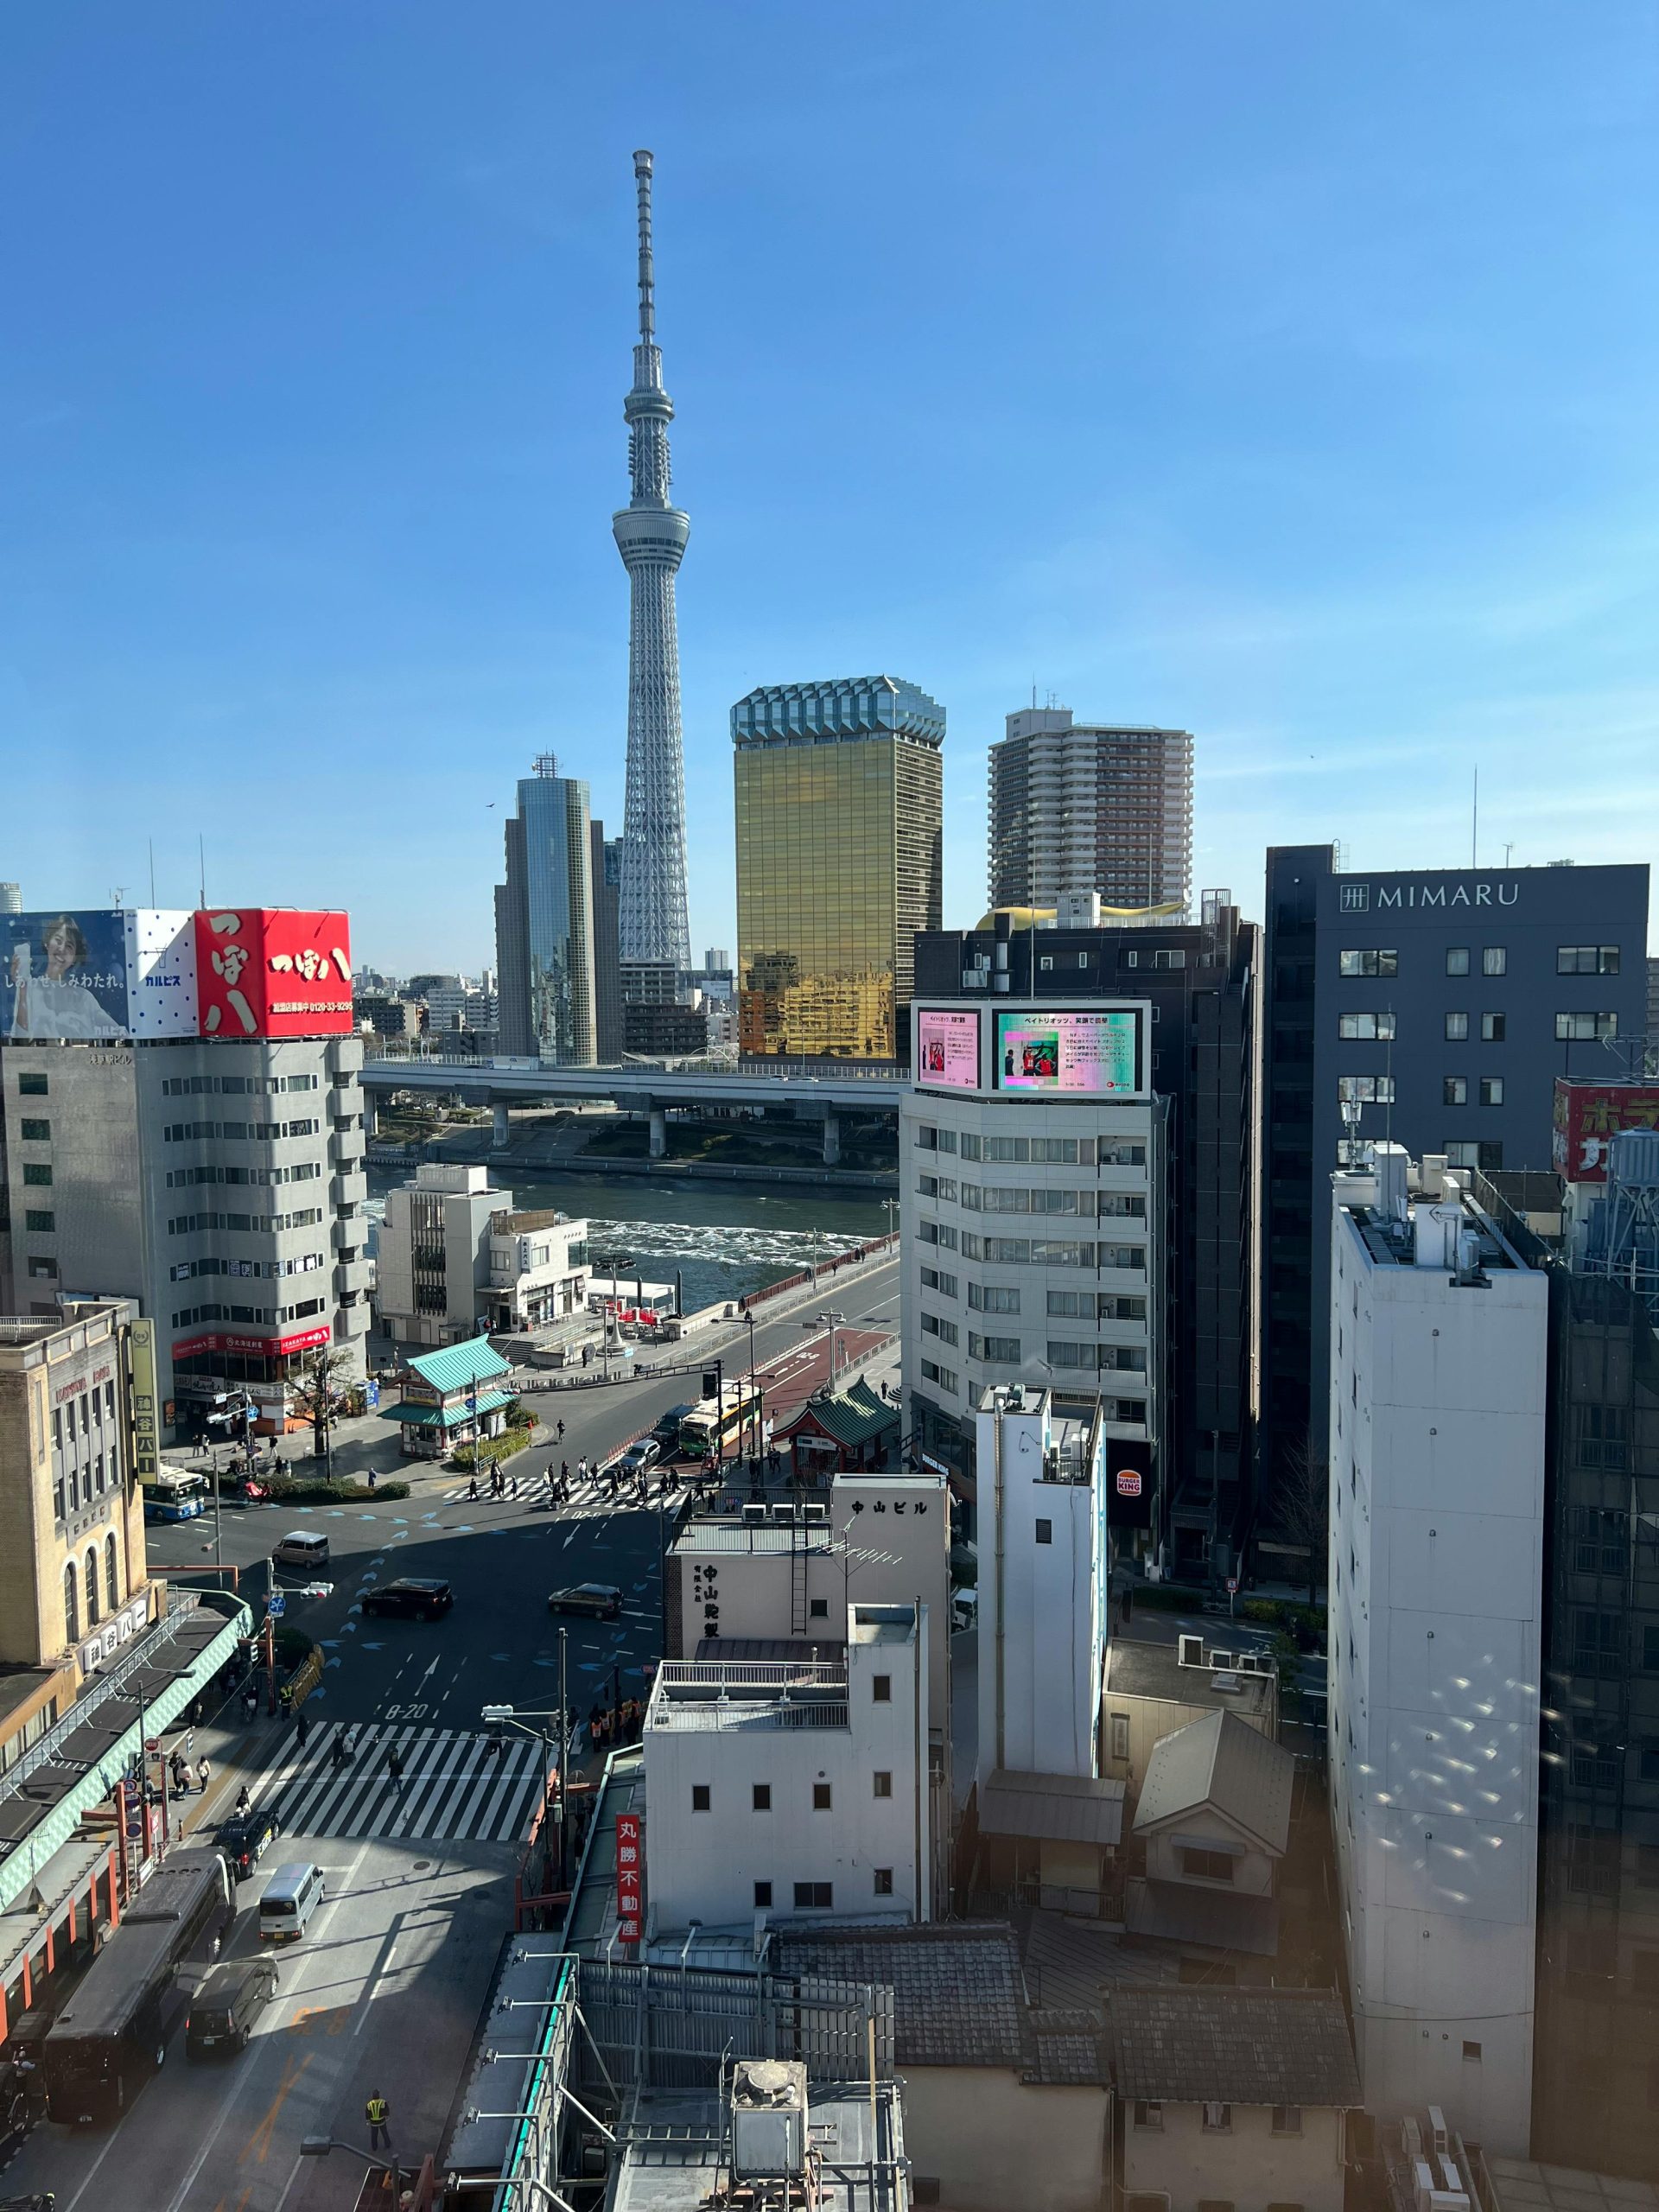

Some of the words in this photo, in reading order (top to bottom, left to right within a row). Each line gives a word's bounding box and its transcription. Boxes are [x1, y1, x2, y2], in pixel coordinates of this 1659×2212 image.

[1377, 883, 1519, 908] MIMARU
[4, 972, 124, 989] しあわせ、しみわたれ。
[145, 976, 181, 987] カルピス
[310, 1001, 353, 1012] 0120-33-9295
[89, 1054, 131, 1065] 浅草駅ビル
[137, 1396, 153, 1471] 神谷バー
[852, 1501, 927, 1515] 中山ビル
[92, 1611, 145, 1664] 神谷バー
[385, 1704, 429, 1719] 8-20
[620, 1822, 639, 1936] 丸勝不動産
